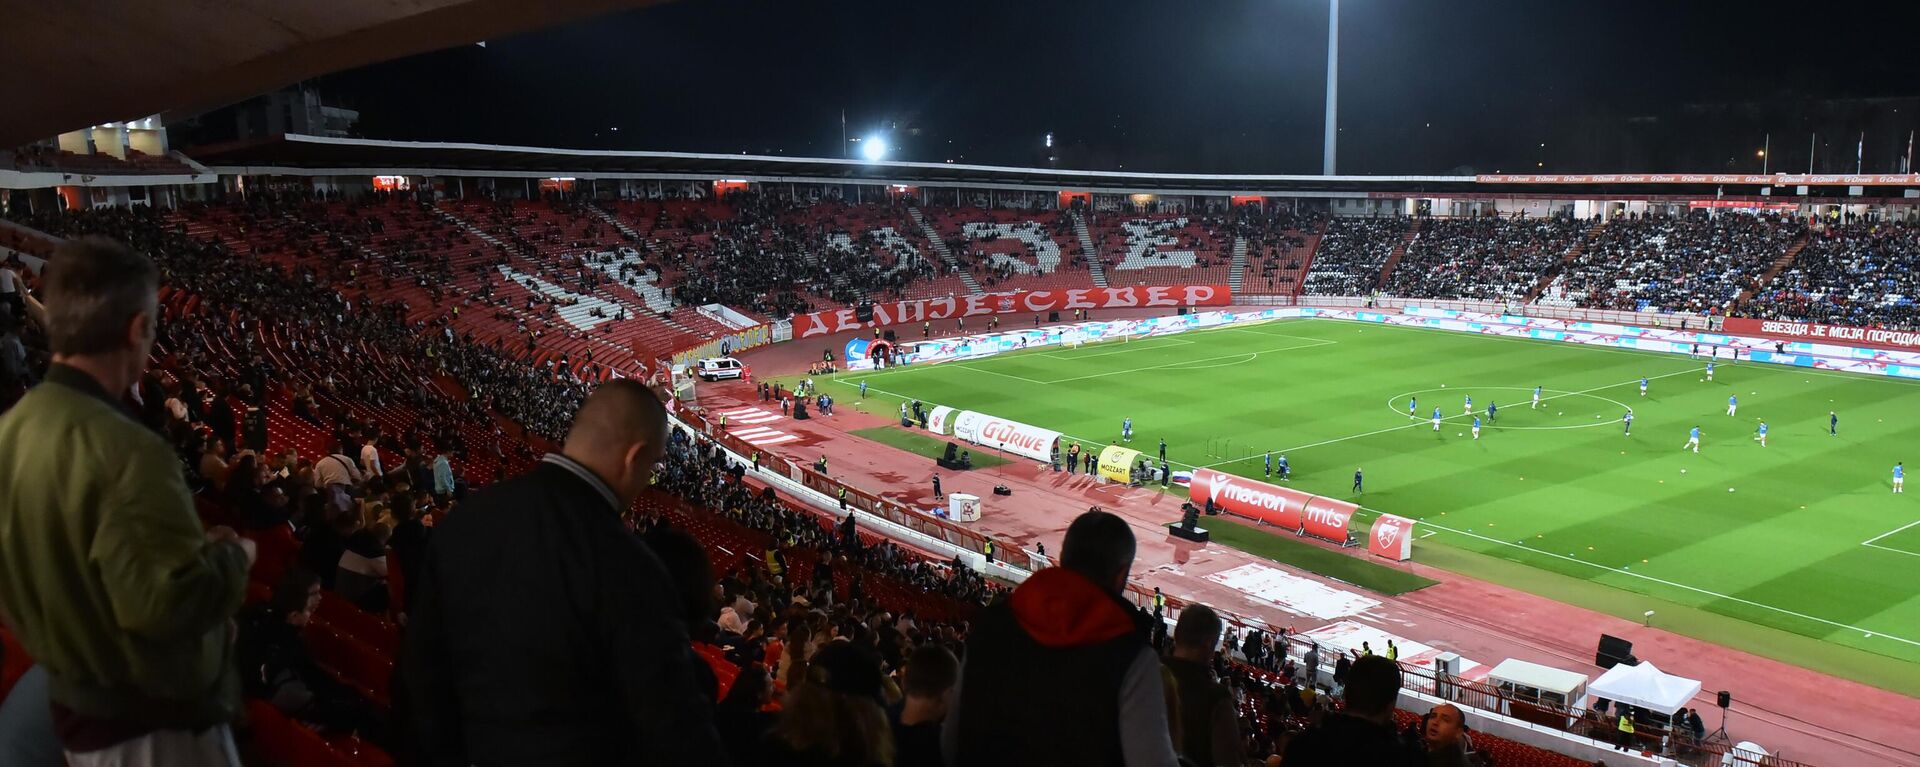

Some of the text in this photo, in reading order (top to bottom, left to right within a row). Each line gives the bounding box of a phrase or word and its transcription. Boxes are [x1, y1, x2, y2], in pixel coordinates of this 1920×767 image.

[1023, 286, 1214, 311] СЕВЕР
[1761, 321, 1808, 336] ЗВЕЗДА
[1810, 325, 1827, 336] ЈЕ
[1829, 327, 1865, 340] МОЈА
[1101, 463, 1126, 475] MOZZART
[1224, 483, 1287, 513] macron
[1307, 506, 1344, 528] mts
